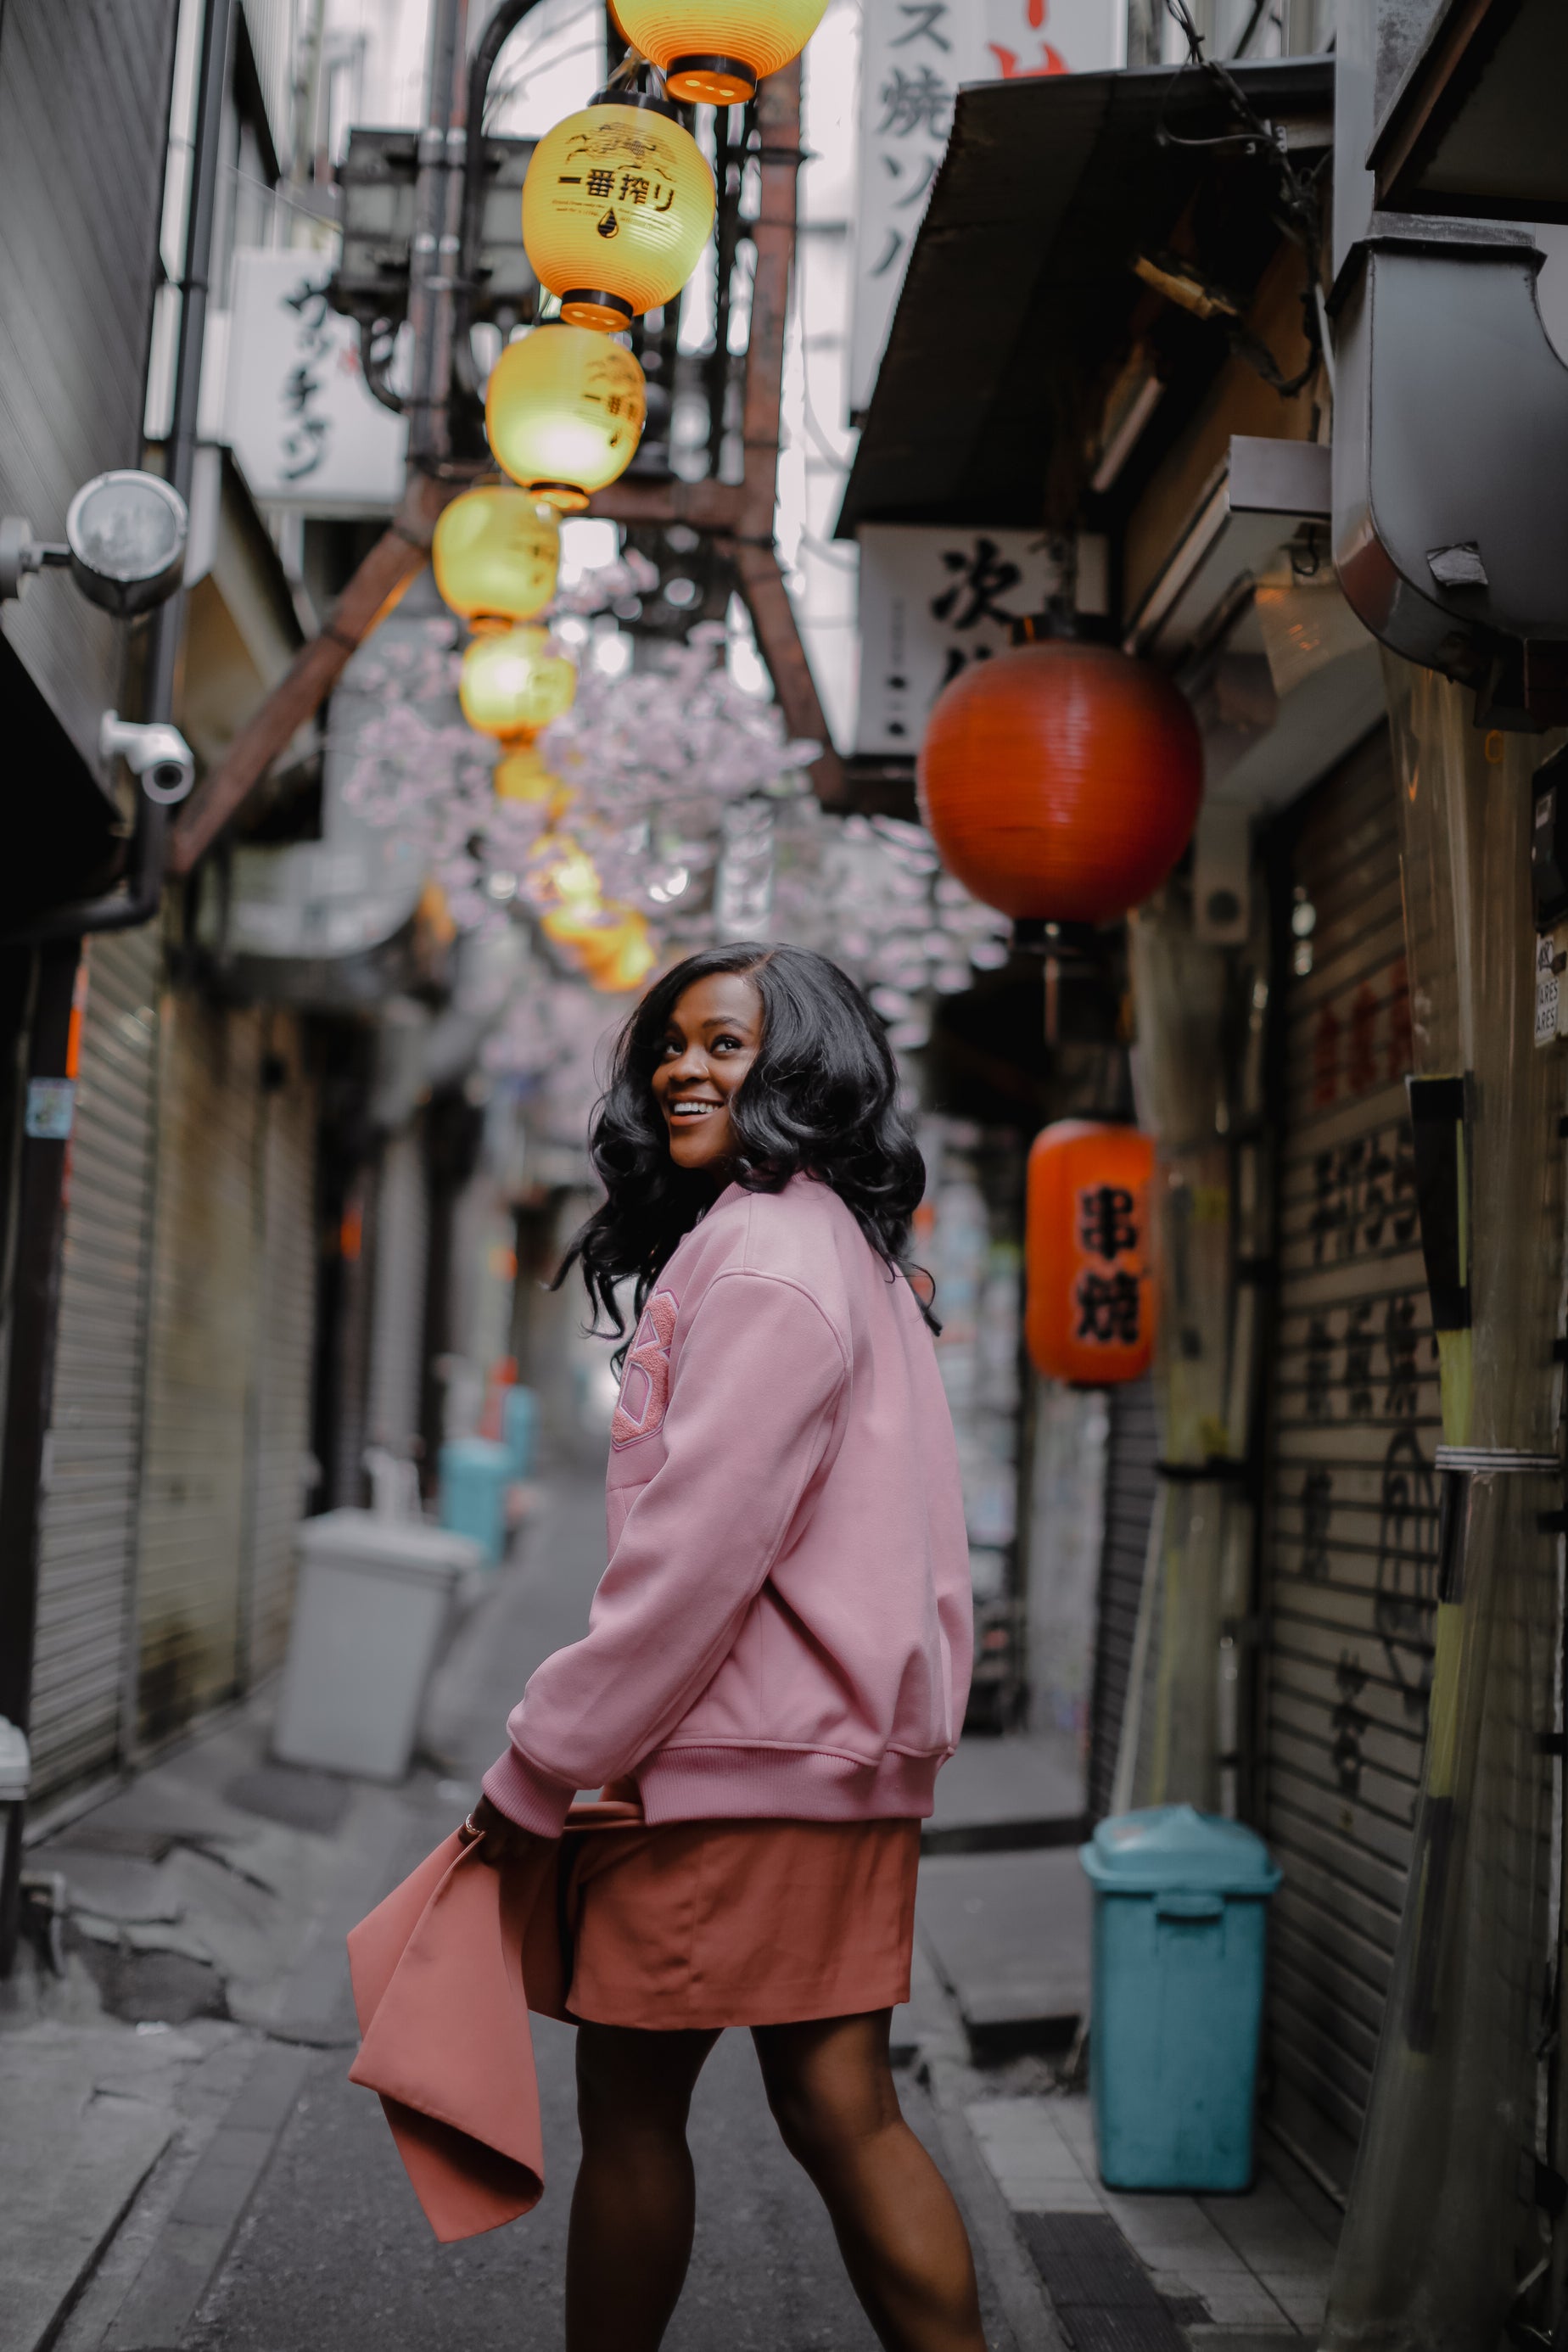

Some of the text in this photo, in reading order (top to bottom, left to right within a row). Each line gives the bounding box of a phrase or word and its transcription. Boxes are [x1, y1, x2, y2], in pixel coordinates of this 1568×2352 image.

[557, 169, 675, 211] 一番搾り
[1536, 1007, 1555, 1033] ARES
[1079, 1184, 1140, 1346] 串焼
